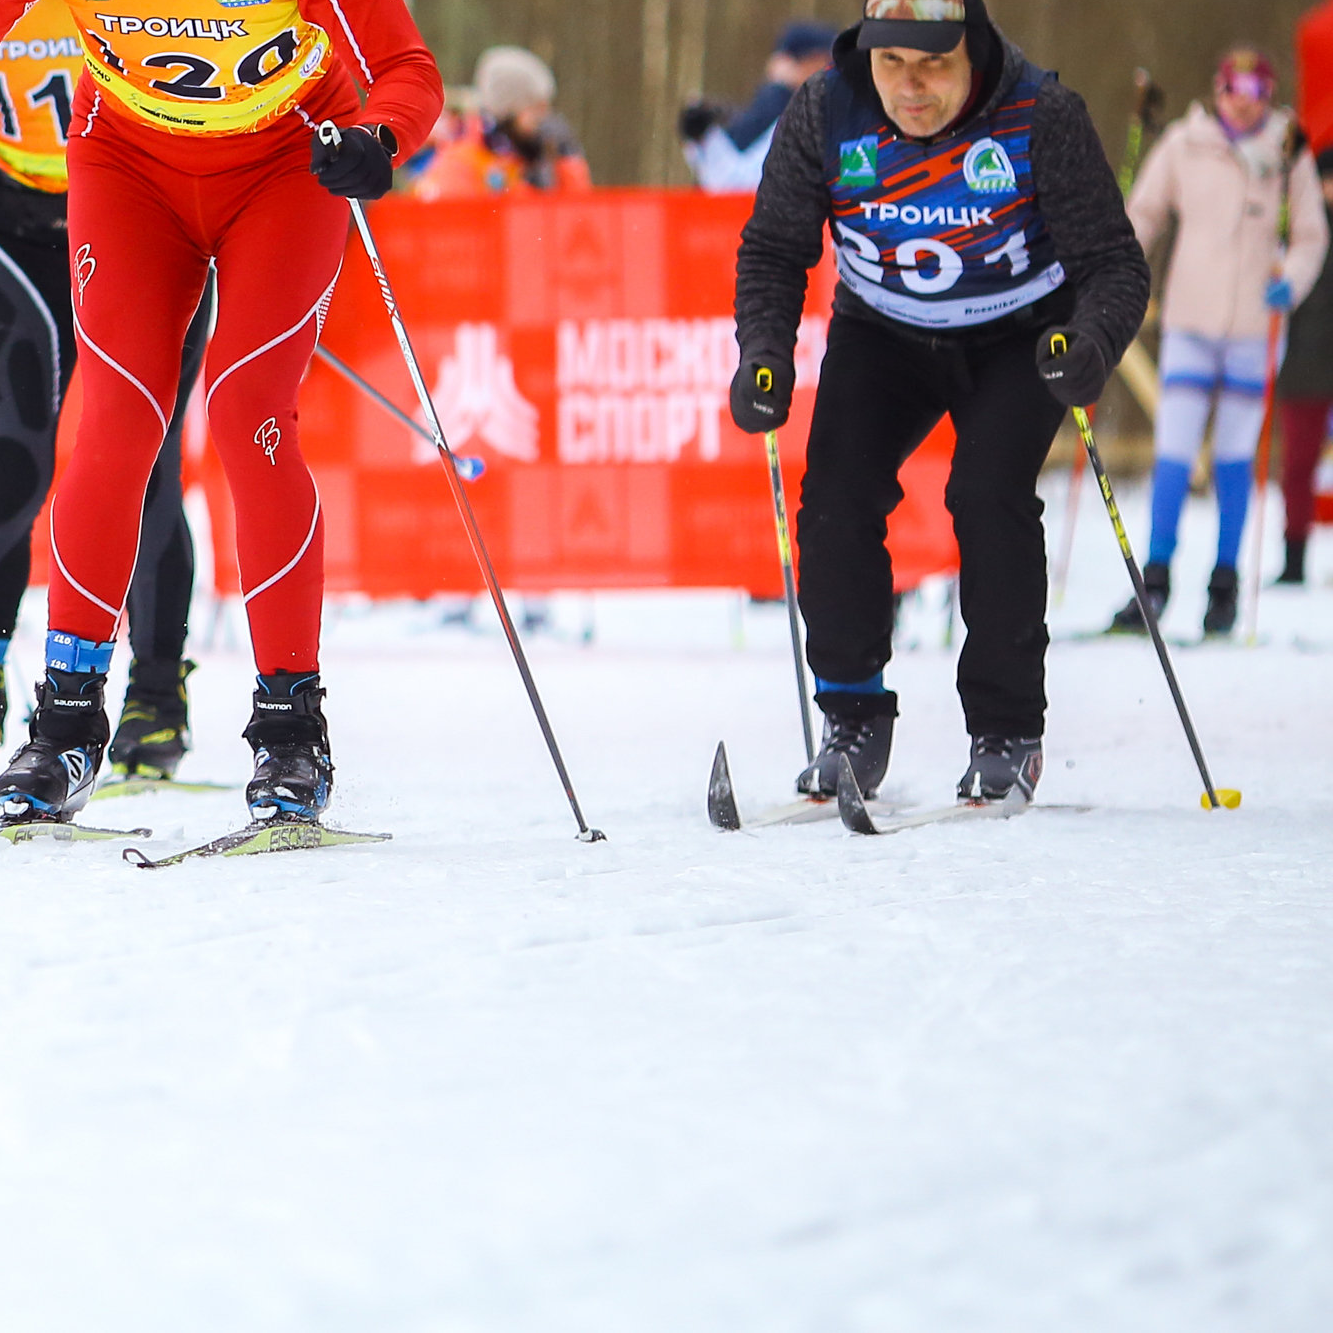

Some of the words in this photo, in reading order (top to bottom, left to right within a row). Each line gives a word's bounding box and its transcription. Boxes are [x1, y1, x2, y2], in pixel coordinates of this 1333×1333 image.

[95, 13, 250, 41] ТРОИЦК
[859, 201, 995, 228] ТРОИЦК
[832, 219, 1030, 295] 201
[557, 391, 721, 464] СПОРТ
[50, 658, 68, 670] 120
[53, 698, 92, 708] salomon
